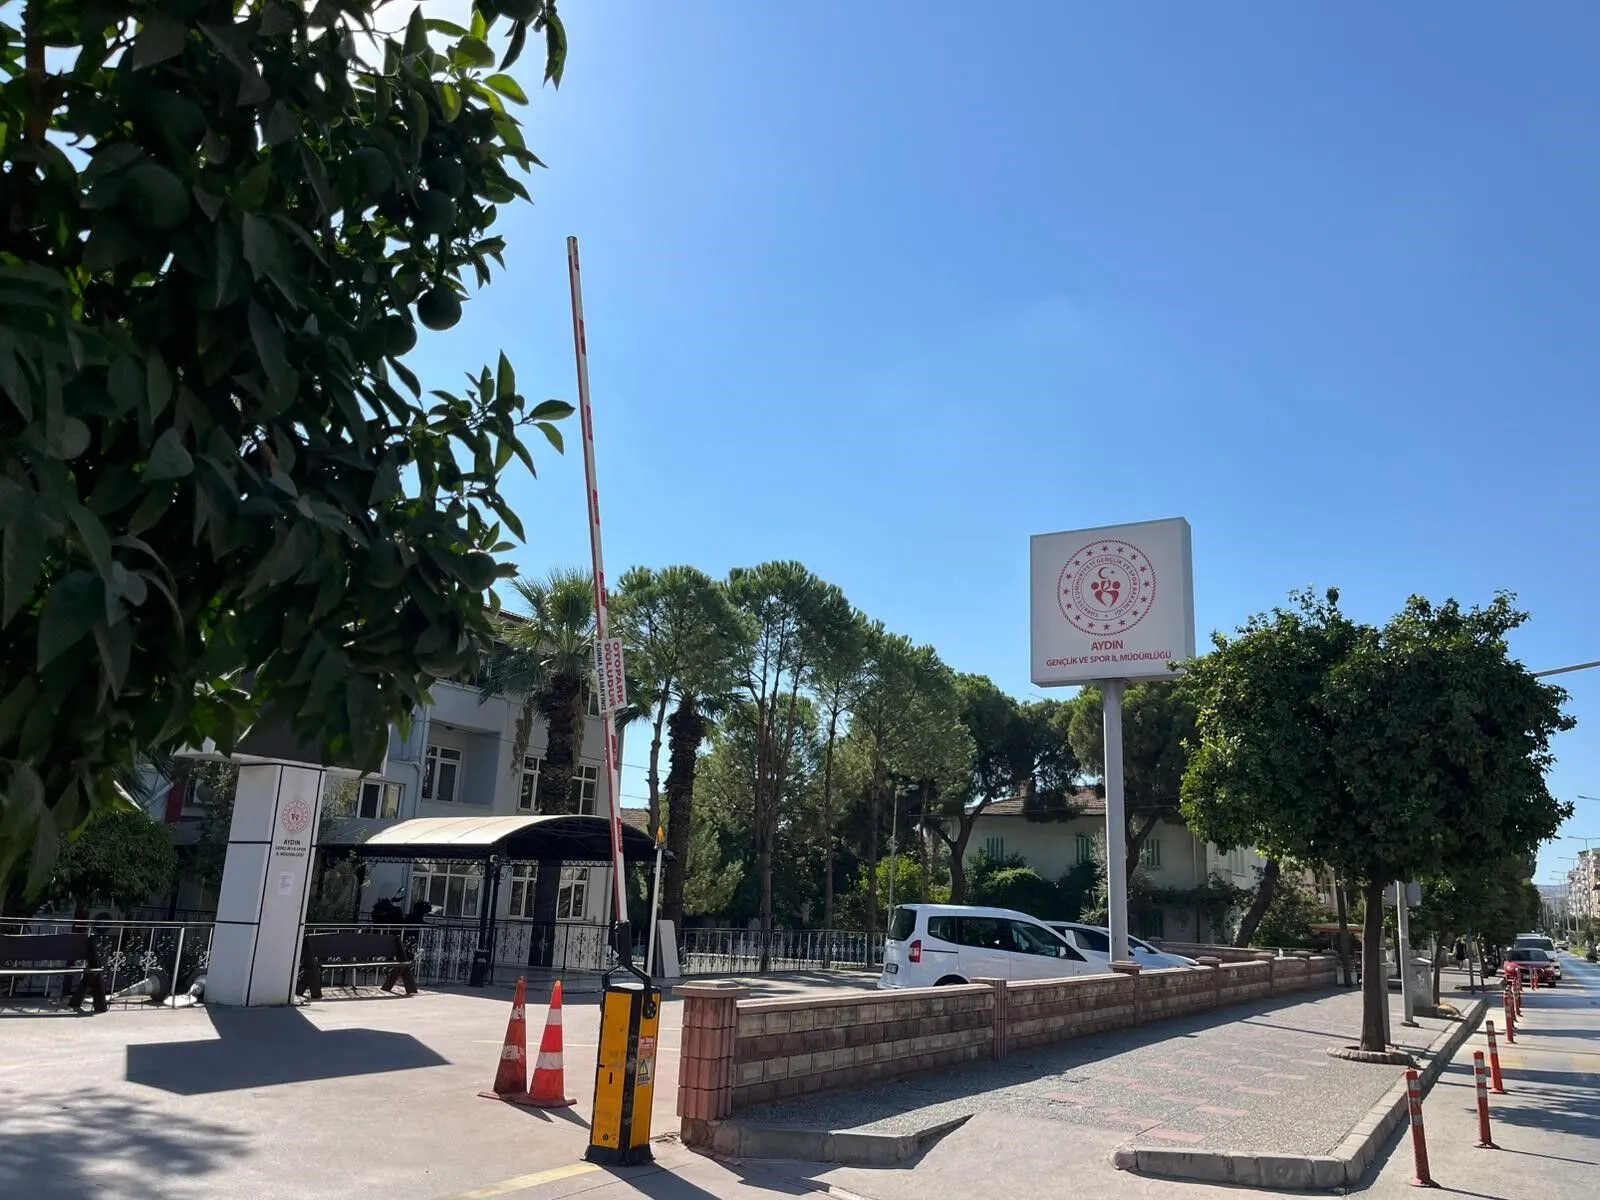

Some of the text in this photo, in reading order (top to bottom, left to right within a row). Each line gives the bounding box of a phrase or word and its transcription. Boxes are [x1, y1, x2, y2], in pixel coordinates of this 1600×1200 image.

[1046, 656, 1078, 668] GENÇLİK
[1079, 656, 1088, 664] VE
[1090, 654, 1110, 664] SPOR
[1119, 651, 1172, 661] MÜDÜRLÜĞÜ
[1091, 640, 1124, 651] AYDIN
[605, 643, 616, 707] DOLUDUR
[614, 641, 624, 704] OTOPARK
